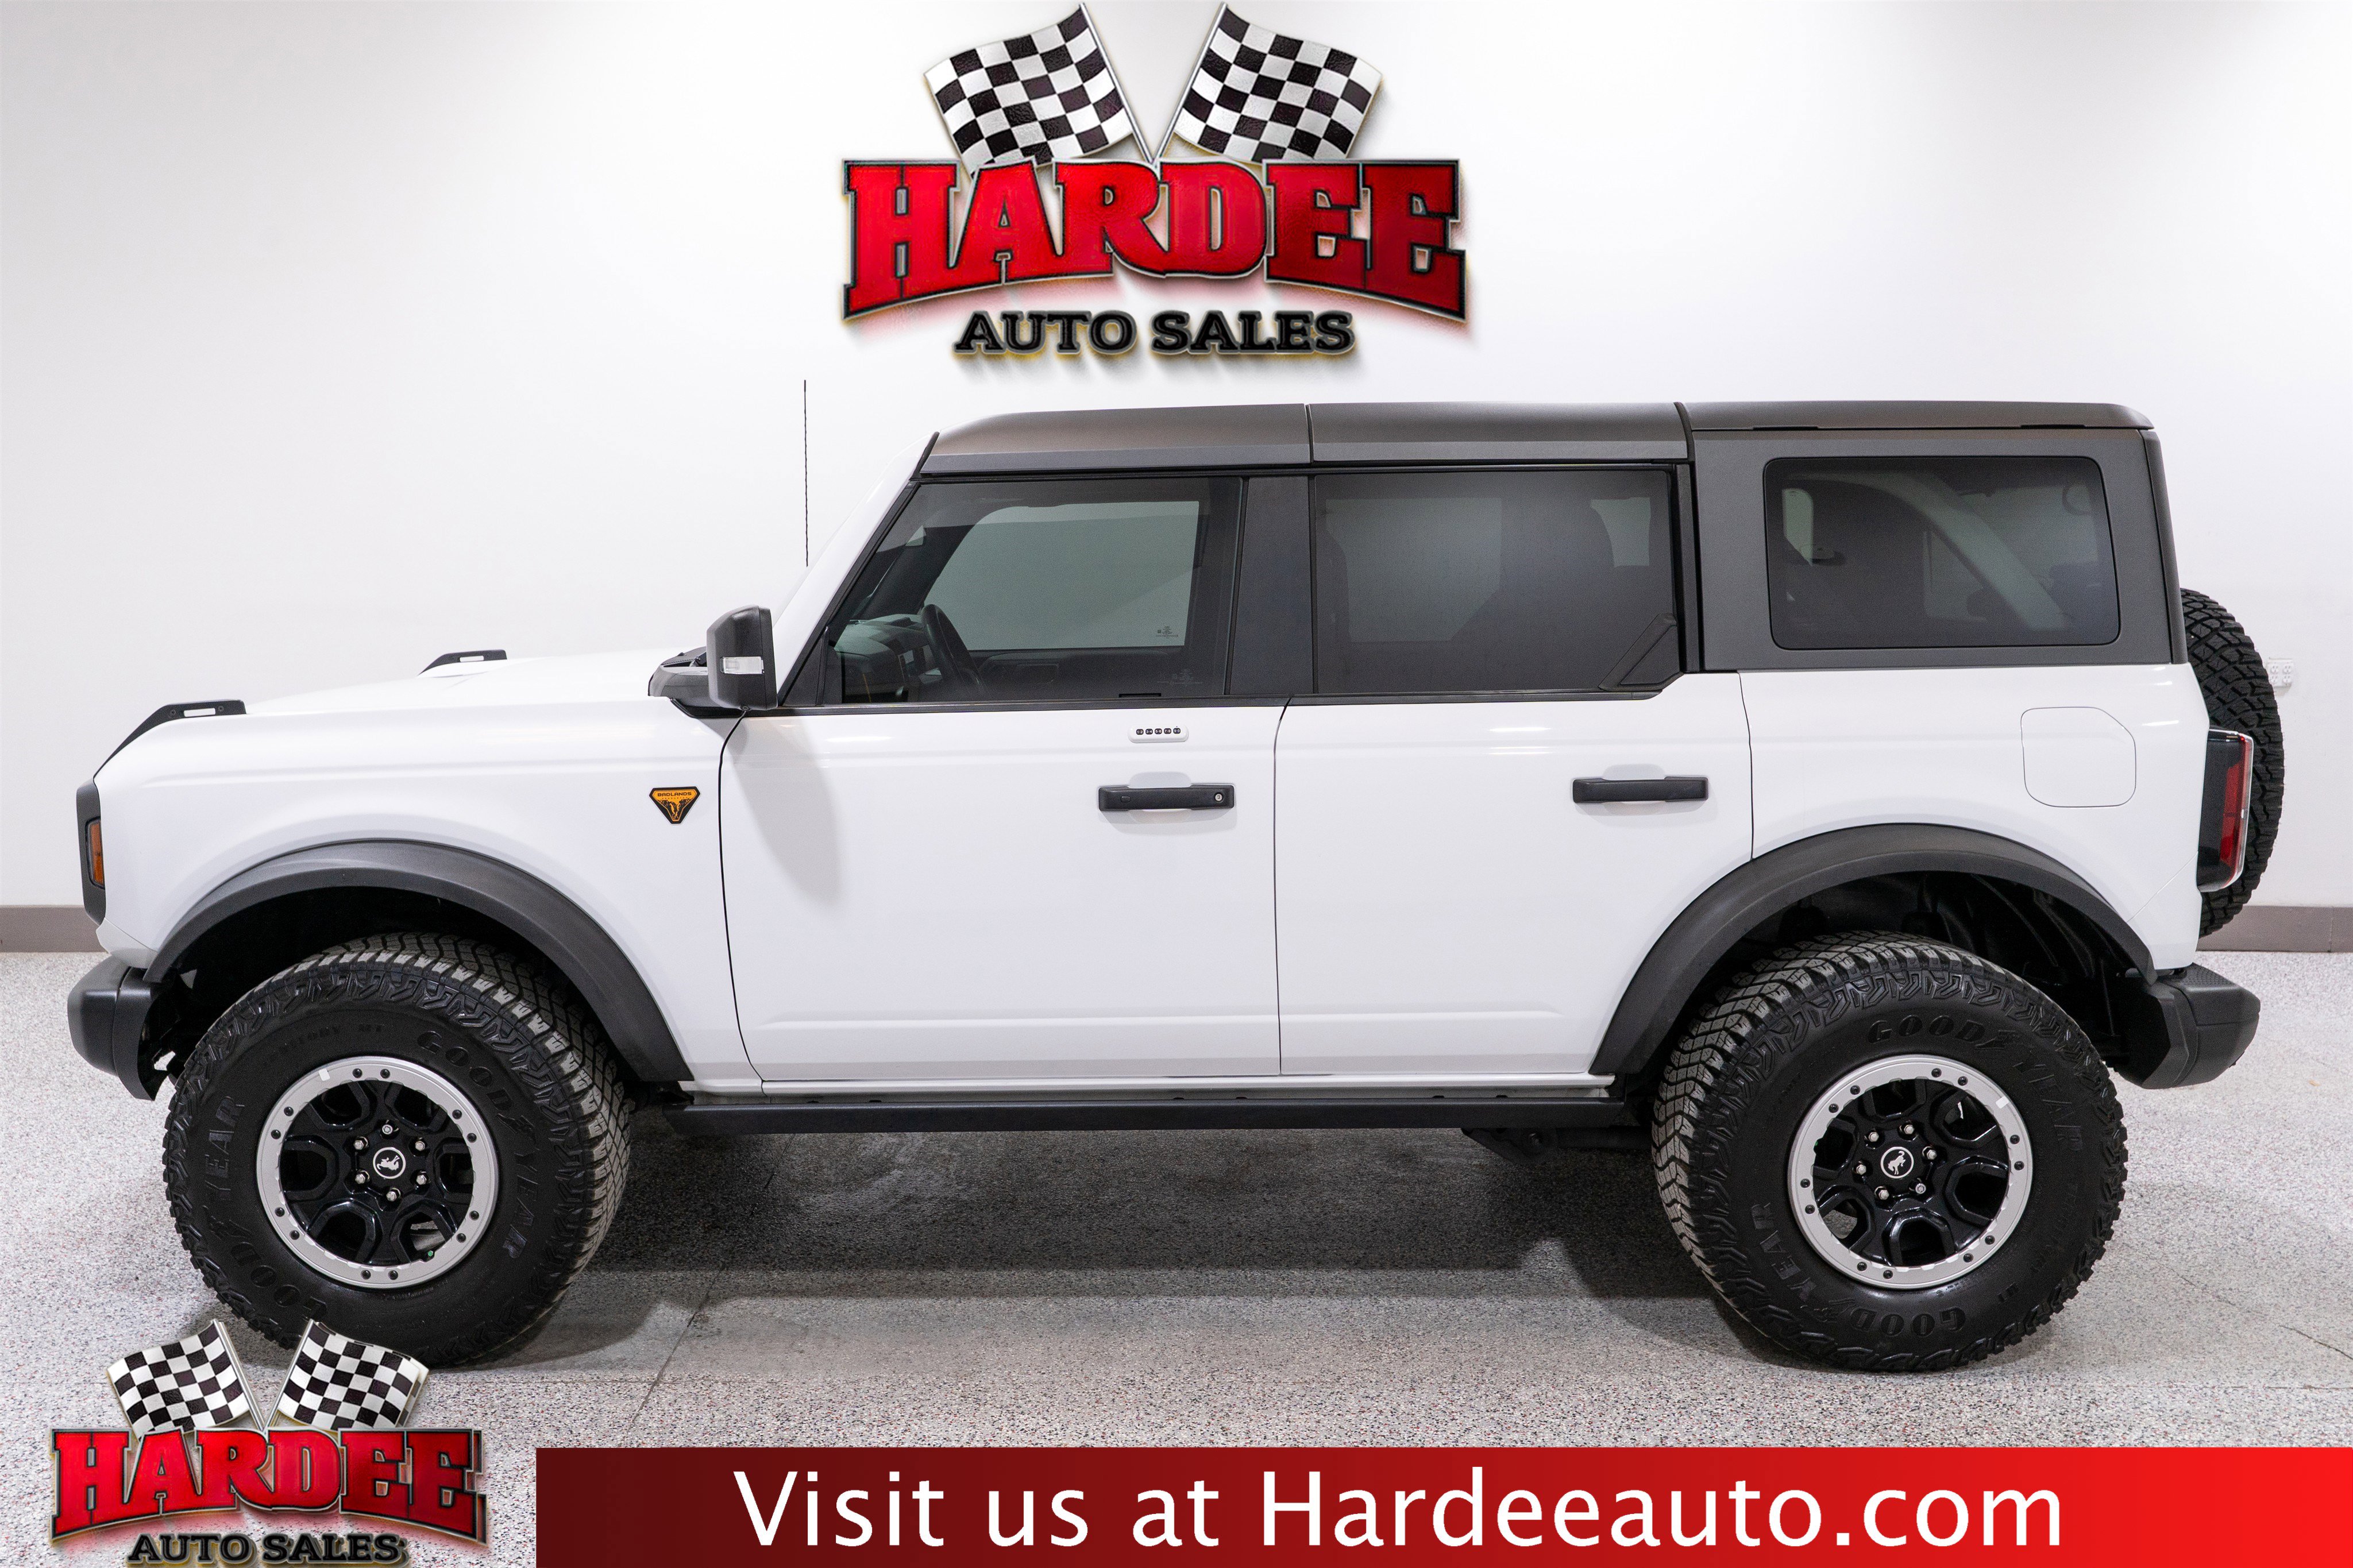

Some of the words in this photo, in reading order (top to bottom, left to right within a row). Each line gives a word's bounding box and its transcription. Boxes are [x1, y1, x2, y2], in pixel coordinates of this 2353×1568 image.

[841, 158, 1467, 322] HARDEE
[954, 311, 1137, 354] AUTO
[1151, 311, 1356, 354] SALES
